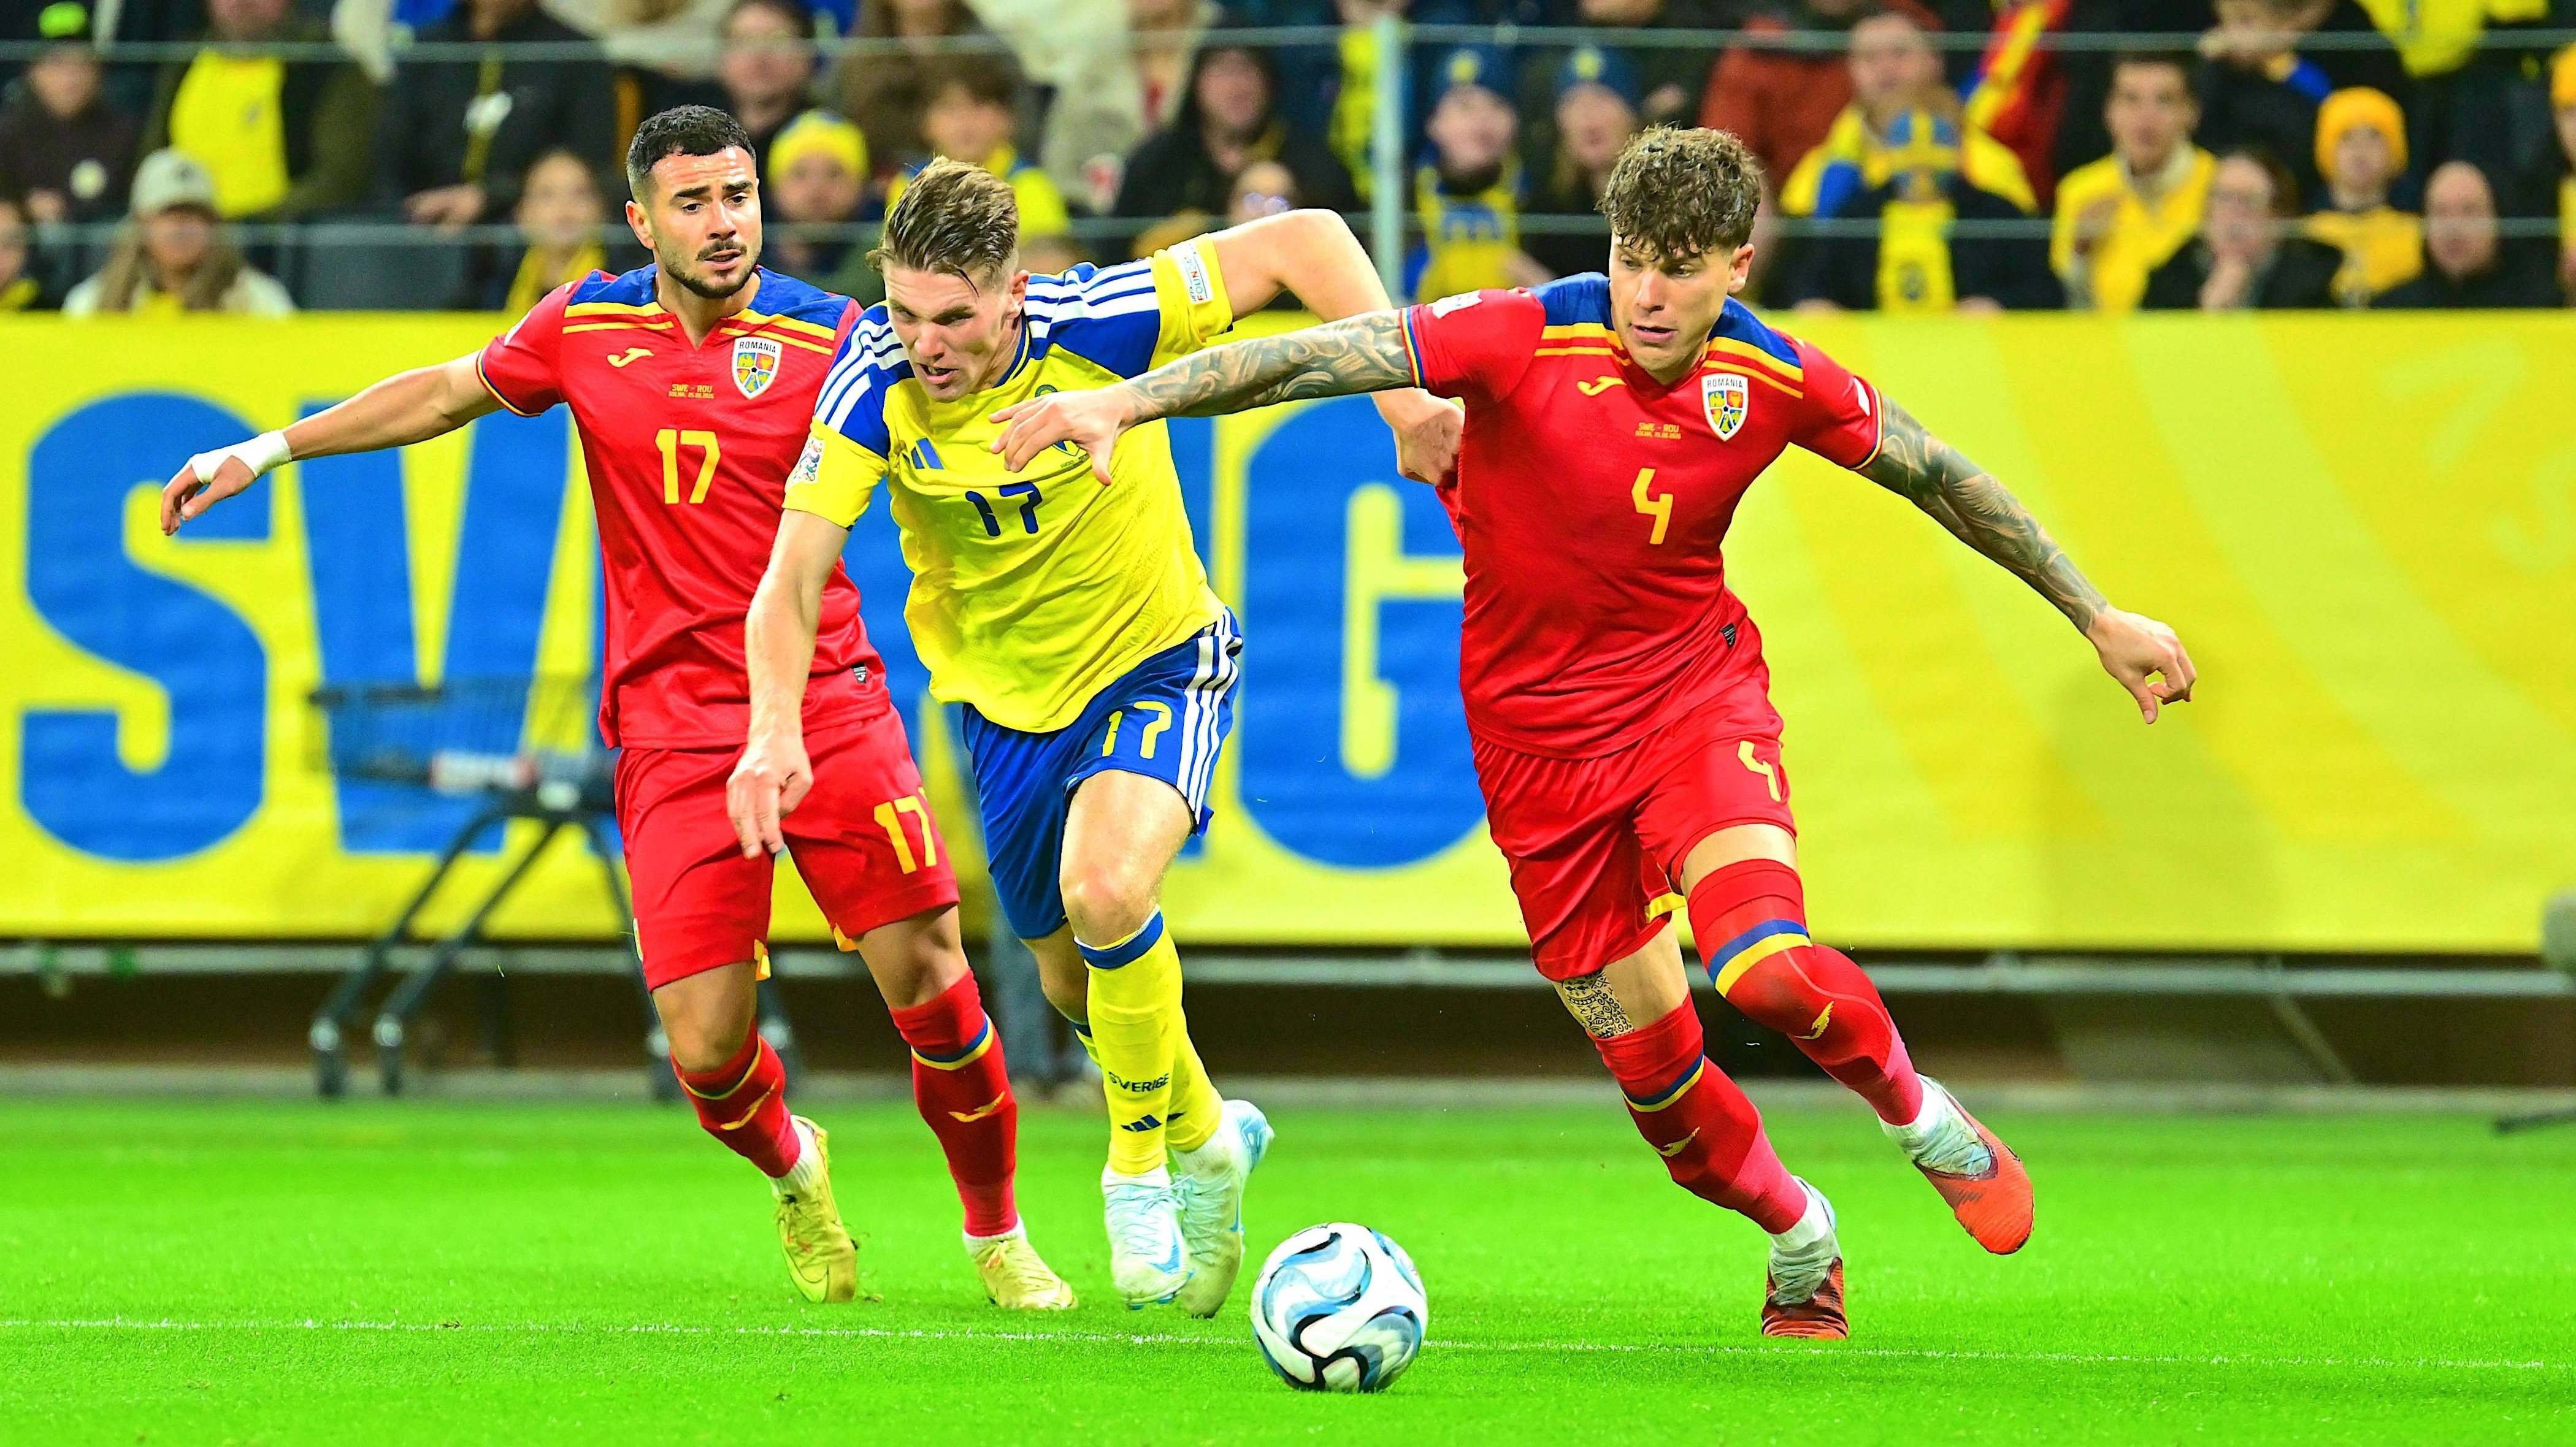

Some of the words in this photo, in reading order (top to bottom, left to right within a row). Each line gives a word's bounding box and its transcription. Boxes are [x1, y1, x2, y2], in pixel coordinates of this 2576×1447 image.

[672, 383, 689, 392] SWE
[697, 384, 713, 393] ROU
[654, 429, 721, 504] 17
[965, 480, 1043, 537] 17
[1631, 467, 1674, 544] 4
[1102, 700, 1172, 759] 17
[1737, 740, 1782, 802] 4
[873, 795, 937, 874] 17
[1108, 1071, 1169, 1093] SVERIGE
